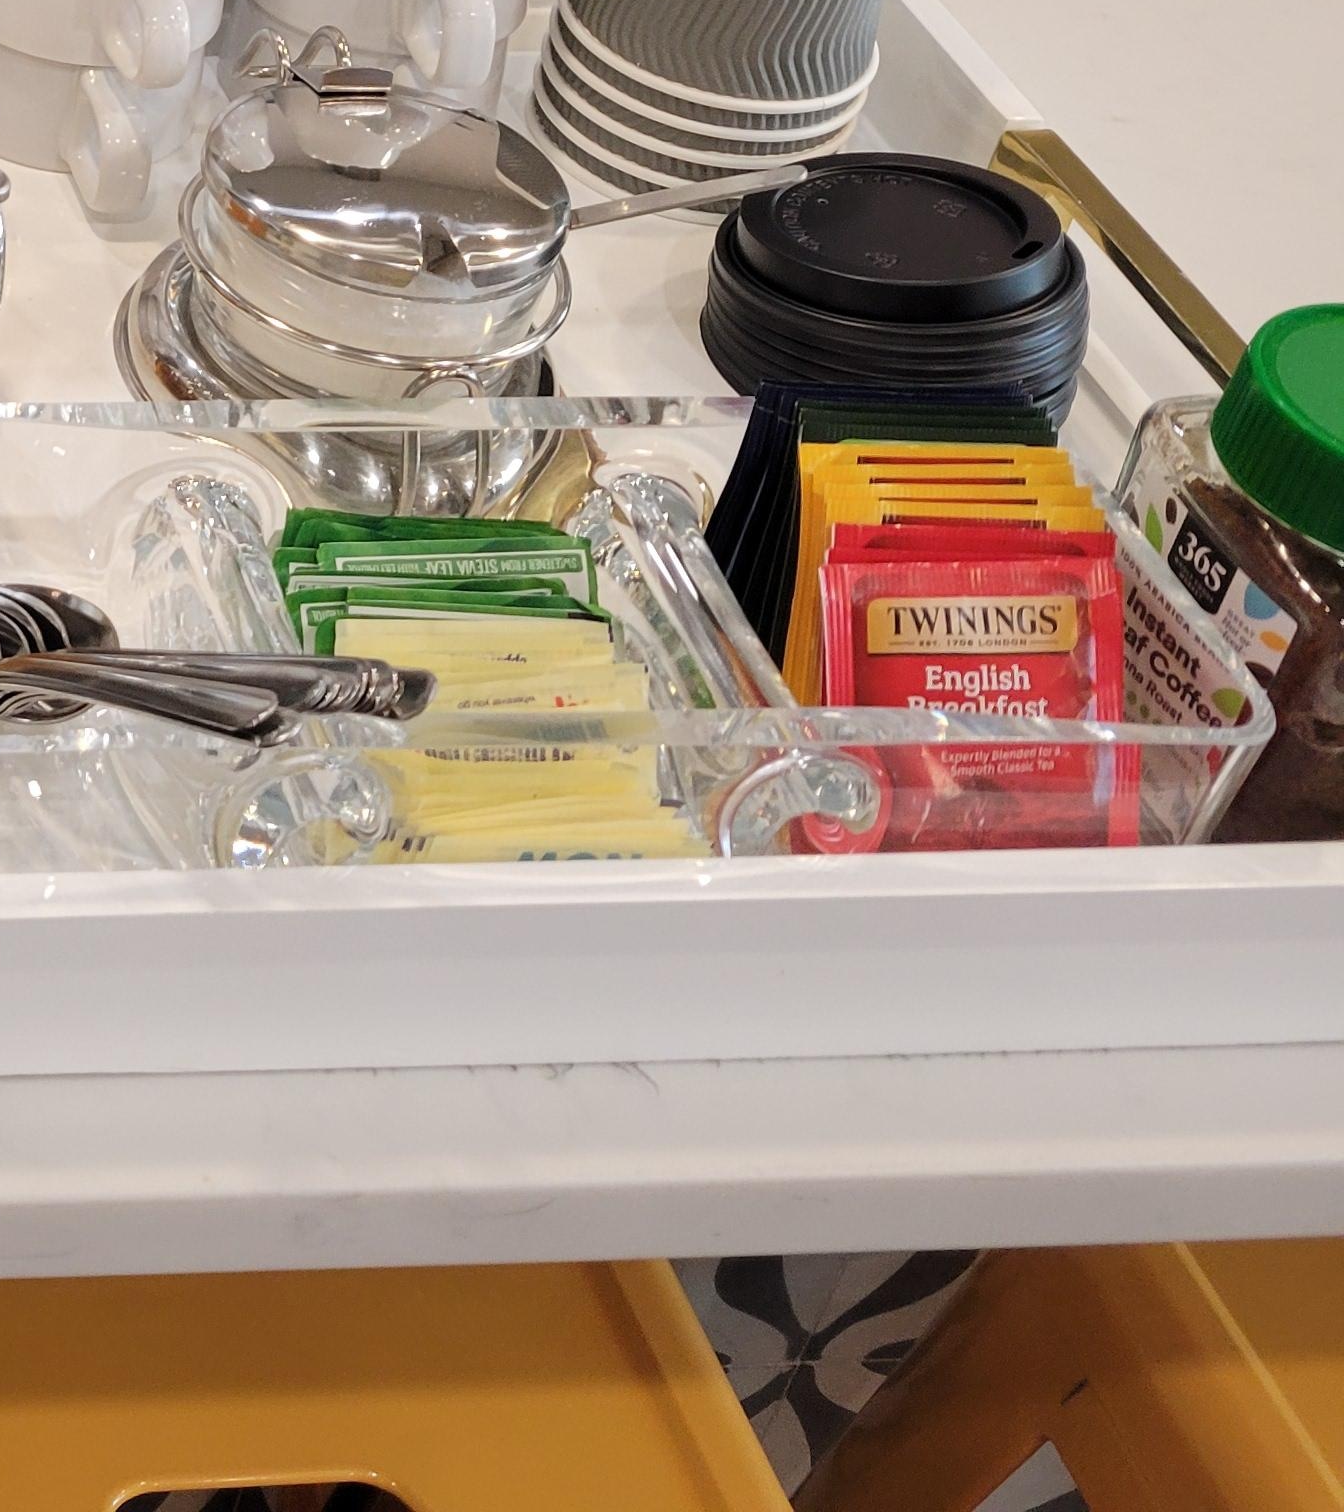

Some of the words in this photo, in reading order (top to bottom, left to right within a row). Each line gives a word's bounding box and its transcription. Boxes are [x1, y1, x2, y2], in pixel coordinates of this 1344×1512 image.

[424, 560, 454, 575] LEAF
[456, 558, 499, 574] STEVIA
[501, 559, 527, 572] FROM
[1178, 532, 1227, 592] 365
[1144, 580, 1191, 632] ARABICA
[888, 605, 1058, 636] TWININGS
[1126, 587, 1201, 679] Instant
[947, 639, 974, 647] 1706
[978, 638, 1028, 647] LONDON
[925, 664, 1031, 698] English
[1149, 651, 1222, 728] Coffee
[457, 699, 471, 709] go
[473, 699, 490, 707] you
[1146, 681, 1183, 725] Roast
[940, 749, 989, 764] Expertly
[992, 747, 1037, 760] Blended
[949, 763, 996, 776] Smooth
[997, 762, 1035, 775] Classic
[1037, 760, 1055, 771] Tea
